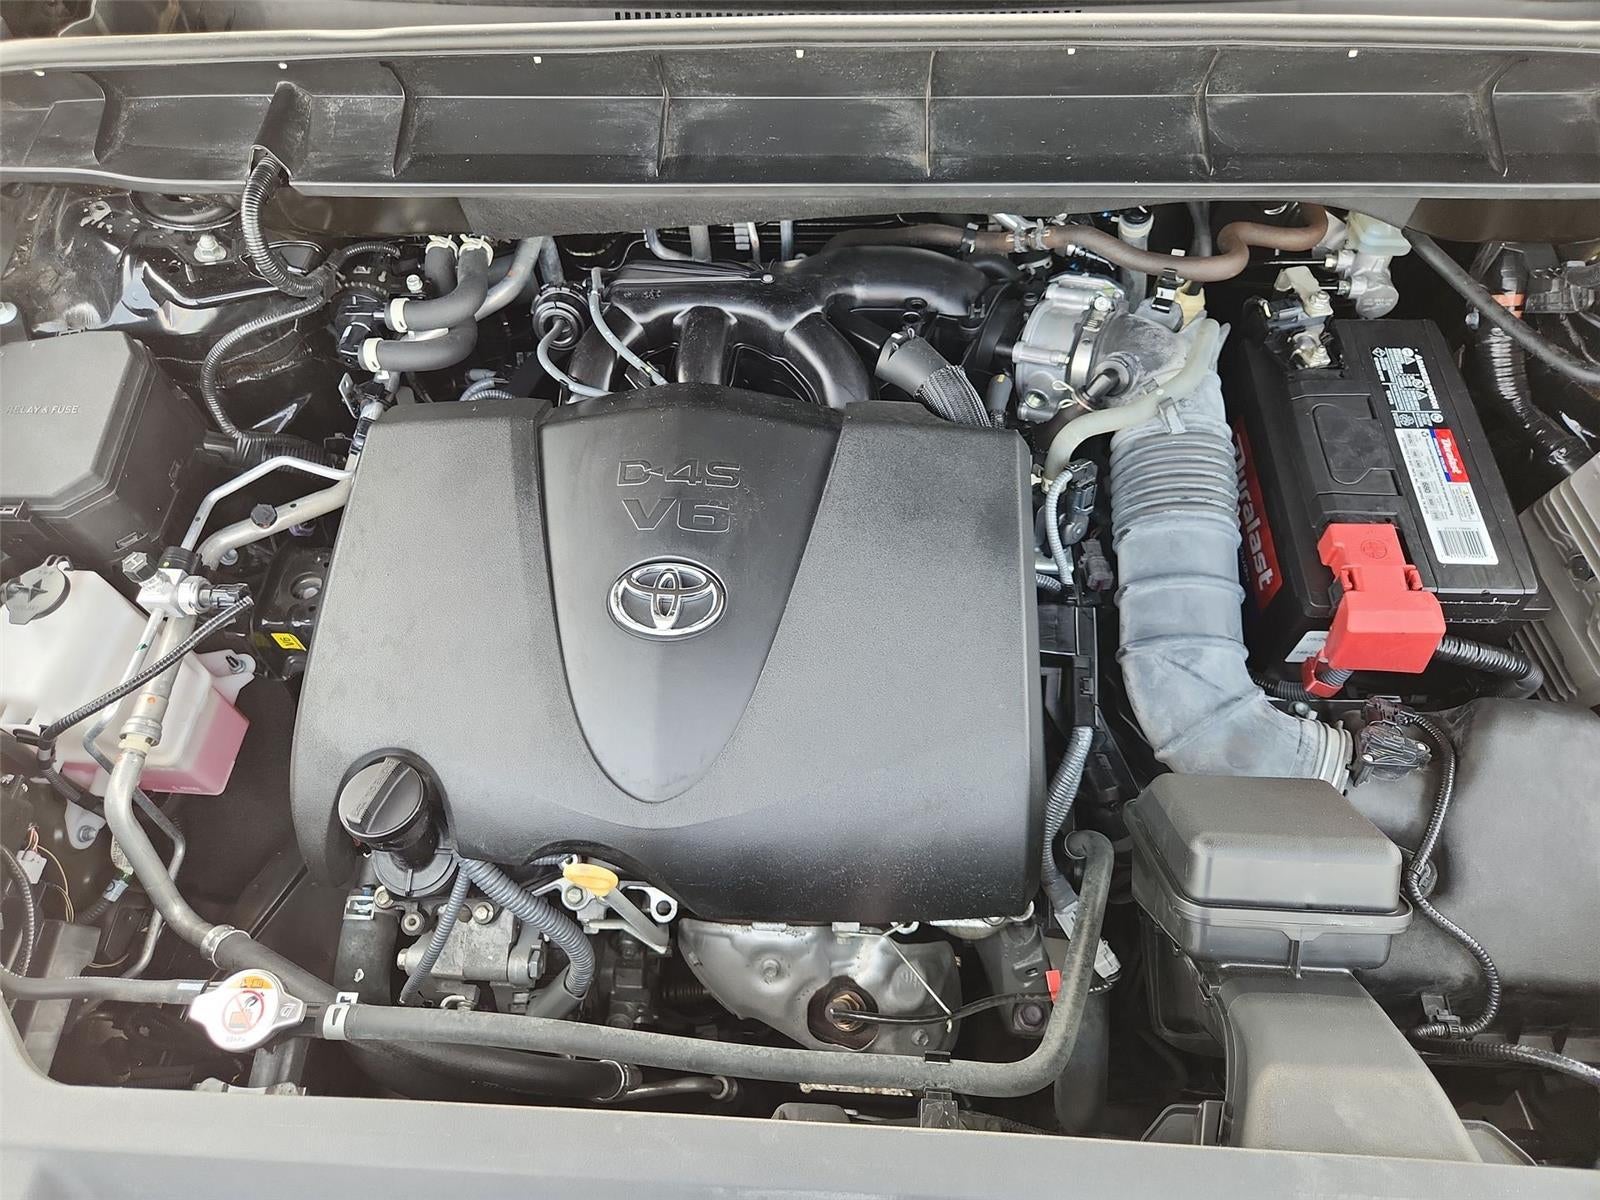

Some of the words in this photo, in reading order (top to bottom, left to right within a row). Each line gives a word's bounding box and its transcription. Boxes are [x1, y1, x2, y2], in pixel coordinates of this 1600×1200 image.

[50, 404, 80, 415] FUSE
[617, 459, 740, 488] D-4S
[622, 498, 730, 533] V6
